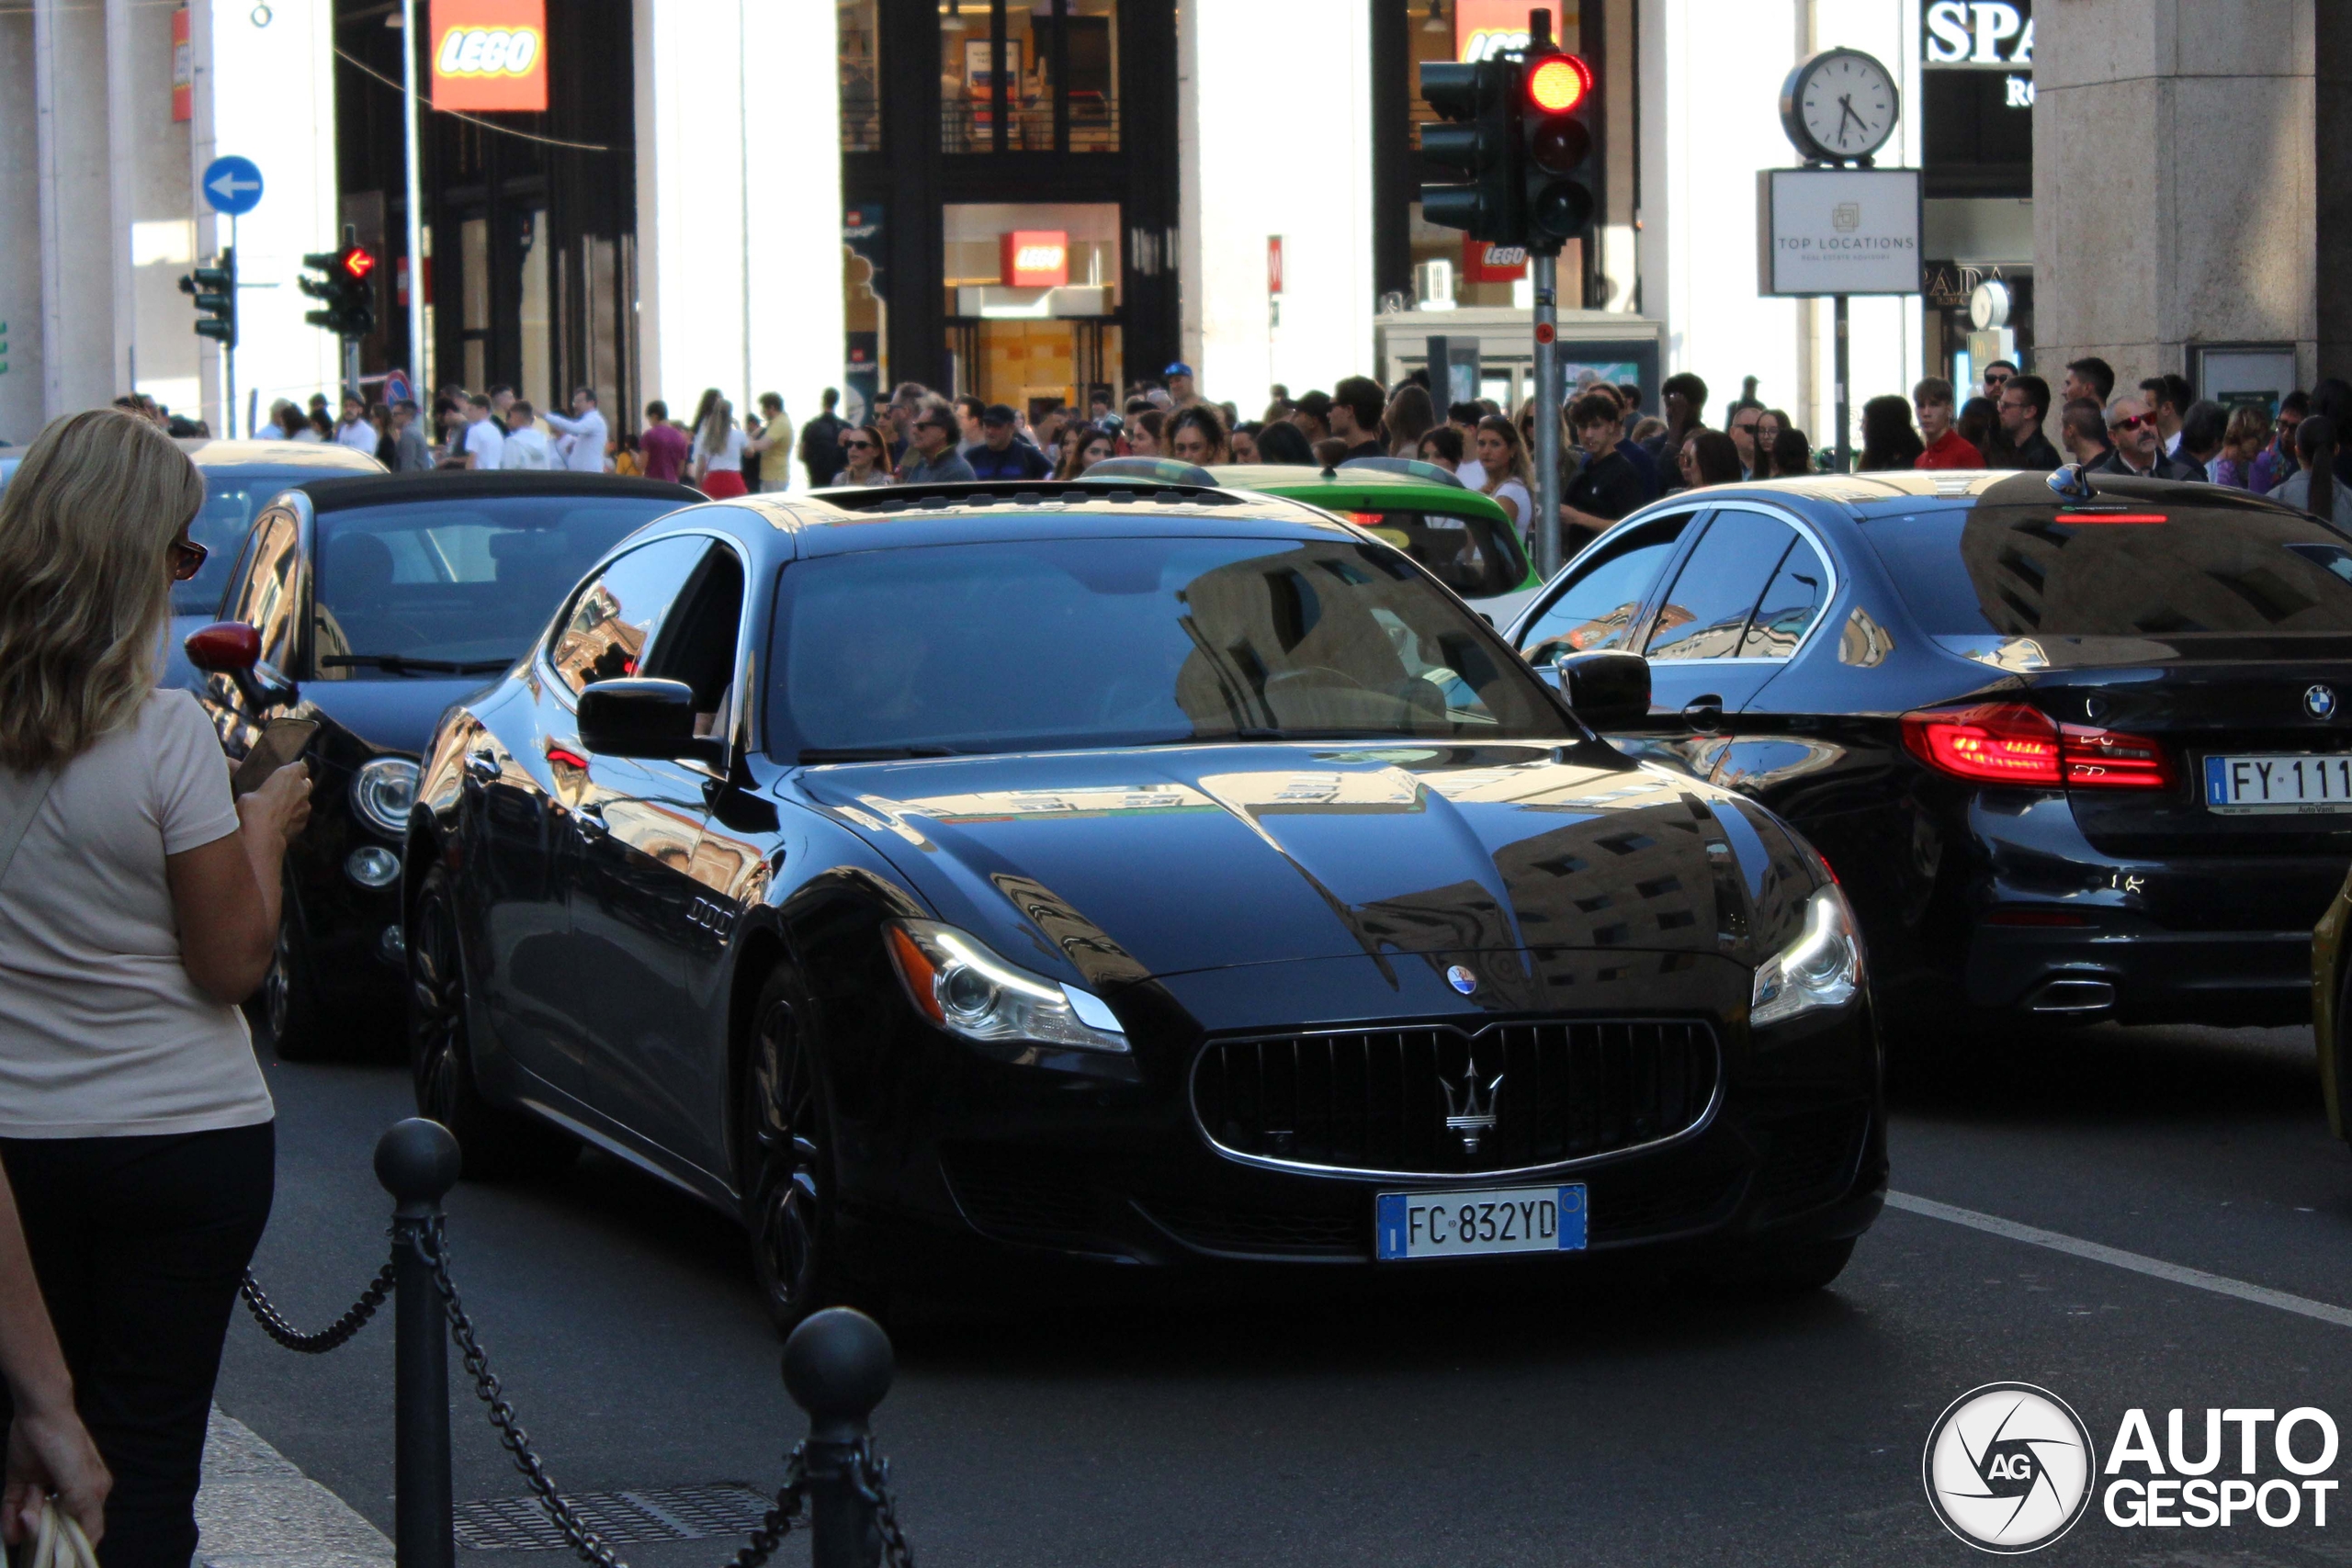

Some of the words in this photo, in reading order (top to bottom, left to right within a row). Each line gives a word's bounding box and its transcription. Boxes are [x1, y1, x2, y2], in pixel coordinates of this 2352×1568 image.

[438, 29, 538, 74] LEGO
[1016, 246, 1063, 269] LEGO
[1483, 245, 1527, 265] LEGO
[1778, 238, 1811, 250] TOP
[1819, 237, 1914, 250] LOCATIONS
[2233, 761, 2273, 800] FY
[2292, 760, 2352, 798] 111
[1408, 1205, 1446, 1247] FC
[1459, 1199, 1557, 1244] 832YD
